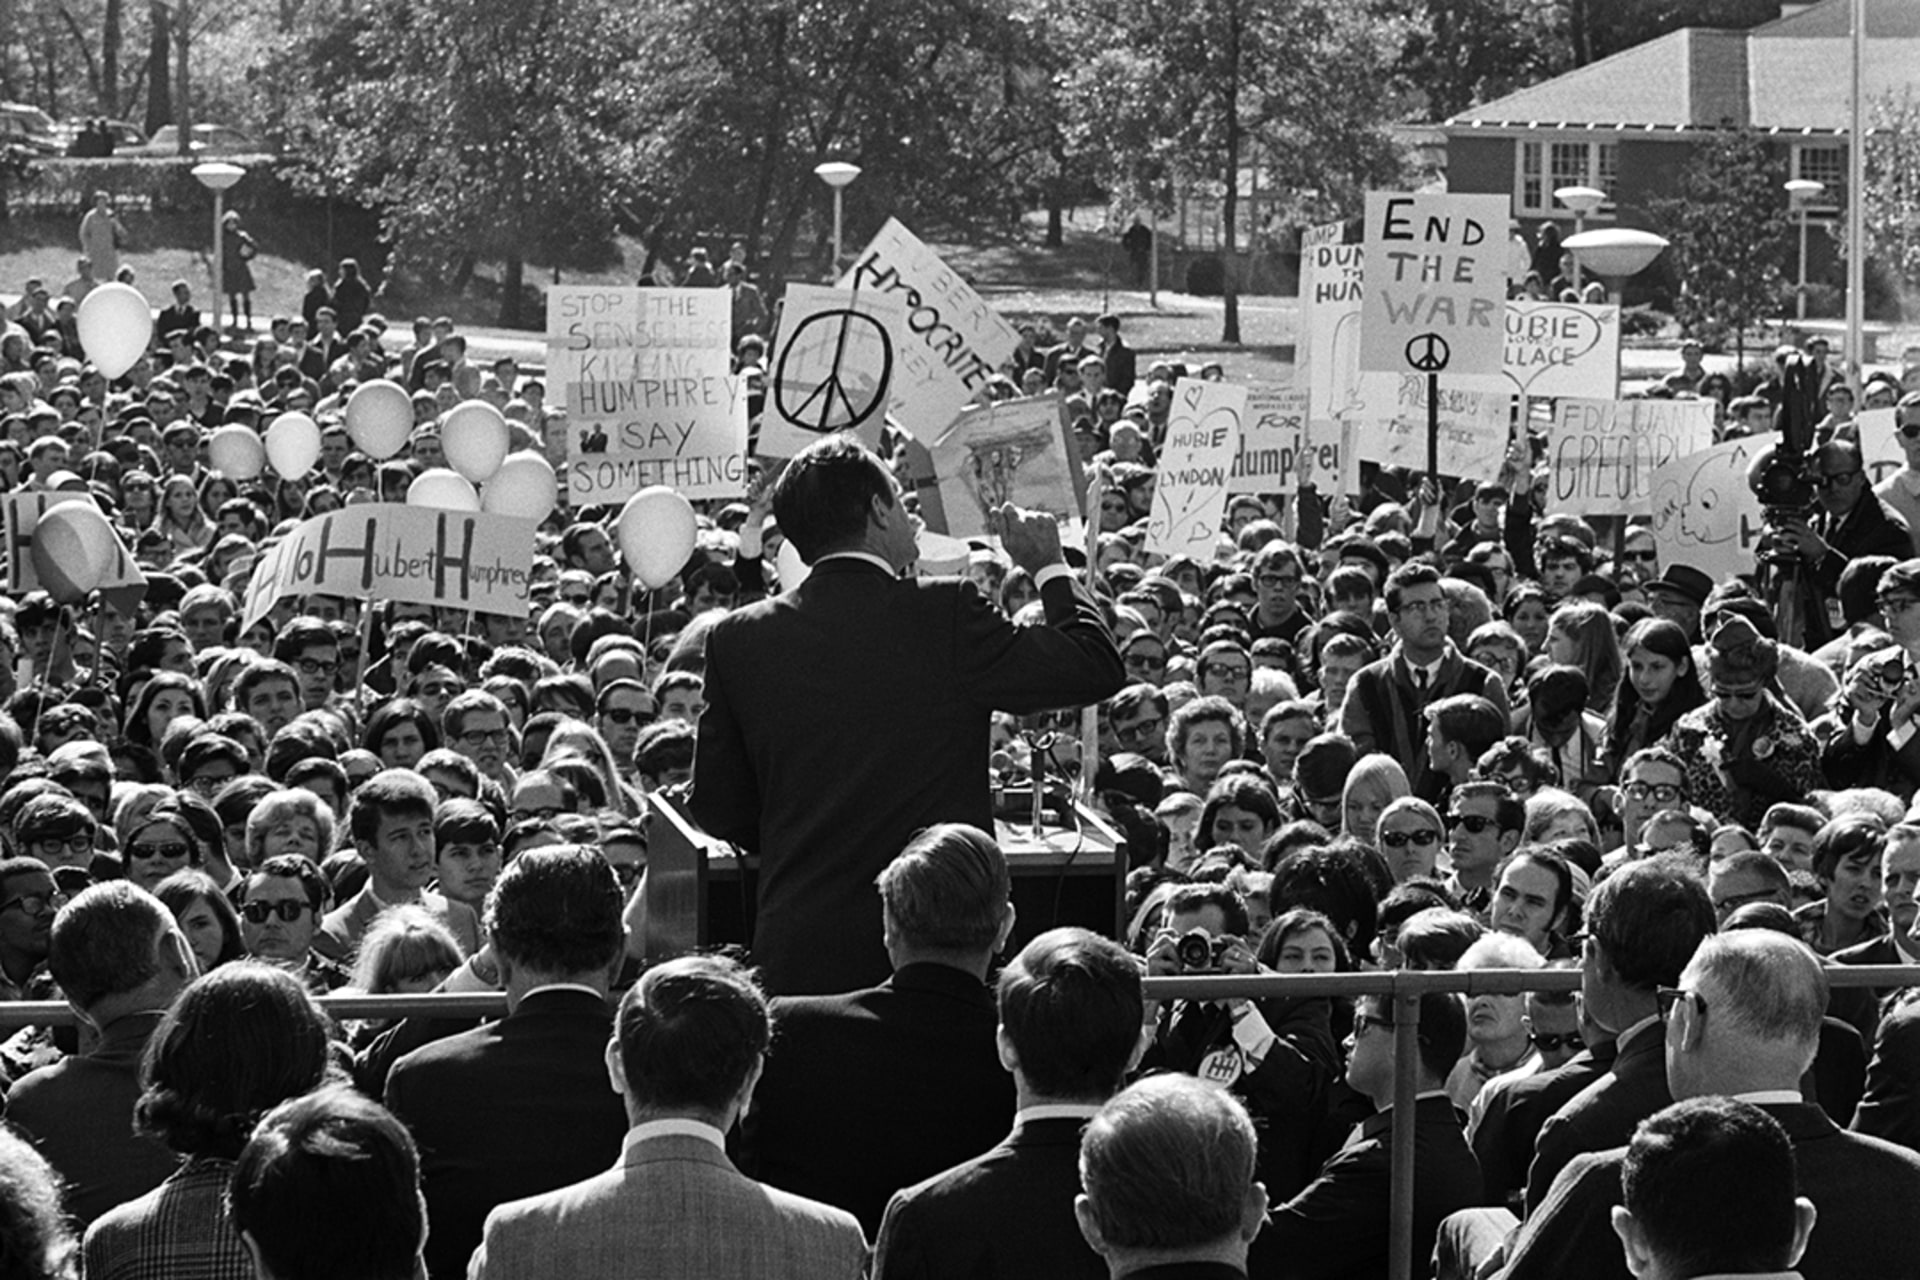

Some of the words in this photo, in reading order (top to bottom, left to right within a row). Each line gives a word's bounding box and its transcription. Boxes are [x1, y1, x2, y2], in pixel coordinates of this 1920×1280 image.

[1382, 198, 1485, 246] END
[1387, 252, 1475, 284] THE
[561, 294, 622, 317] STOP
[650, 296, 698, 317] THE
[1380, 290, 1496, 327] WAR
[568, 320, 728, 351] SENSELESS
[860, 252, 995, 391] HYPOCRITE
[1505, 314, 1582, 339] UBIE
[1504, 346, 1575, 366] LLACE
[1256, 413, 1302, 430] FOR
[1562, 404, 1617, 434] FDU
[621, 420, 696, 456] SAY
[1172, 427, 1228, 448] HUBIE
[1160, 467, 1224, 488] LYNDON
[314, 516, 437, 590] Hubert
[434, 512, 531, 600] Humphrey
